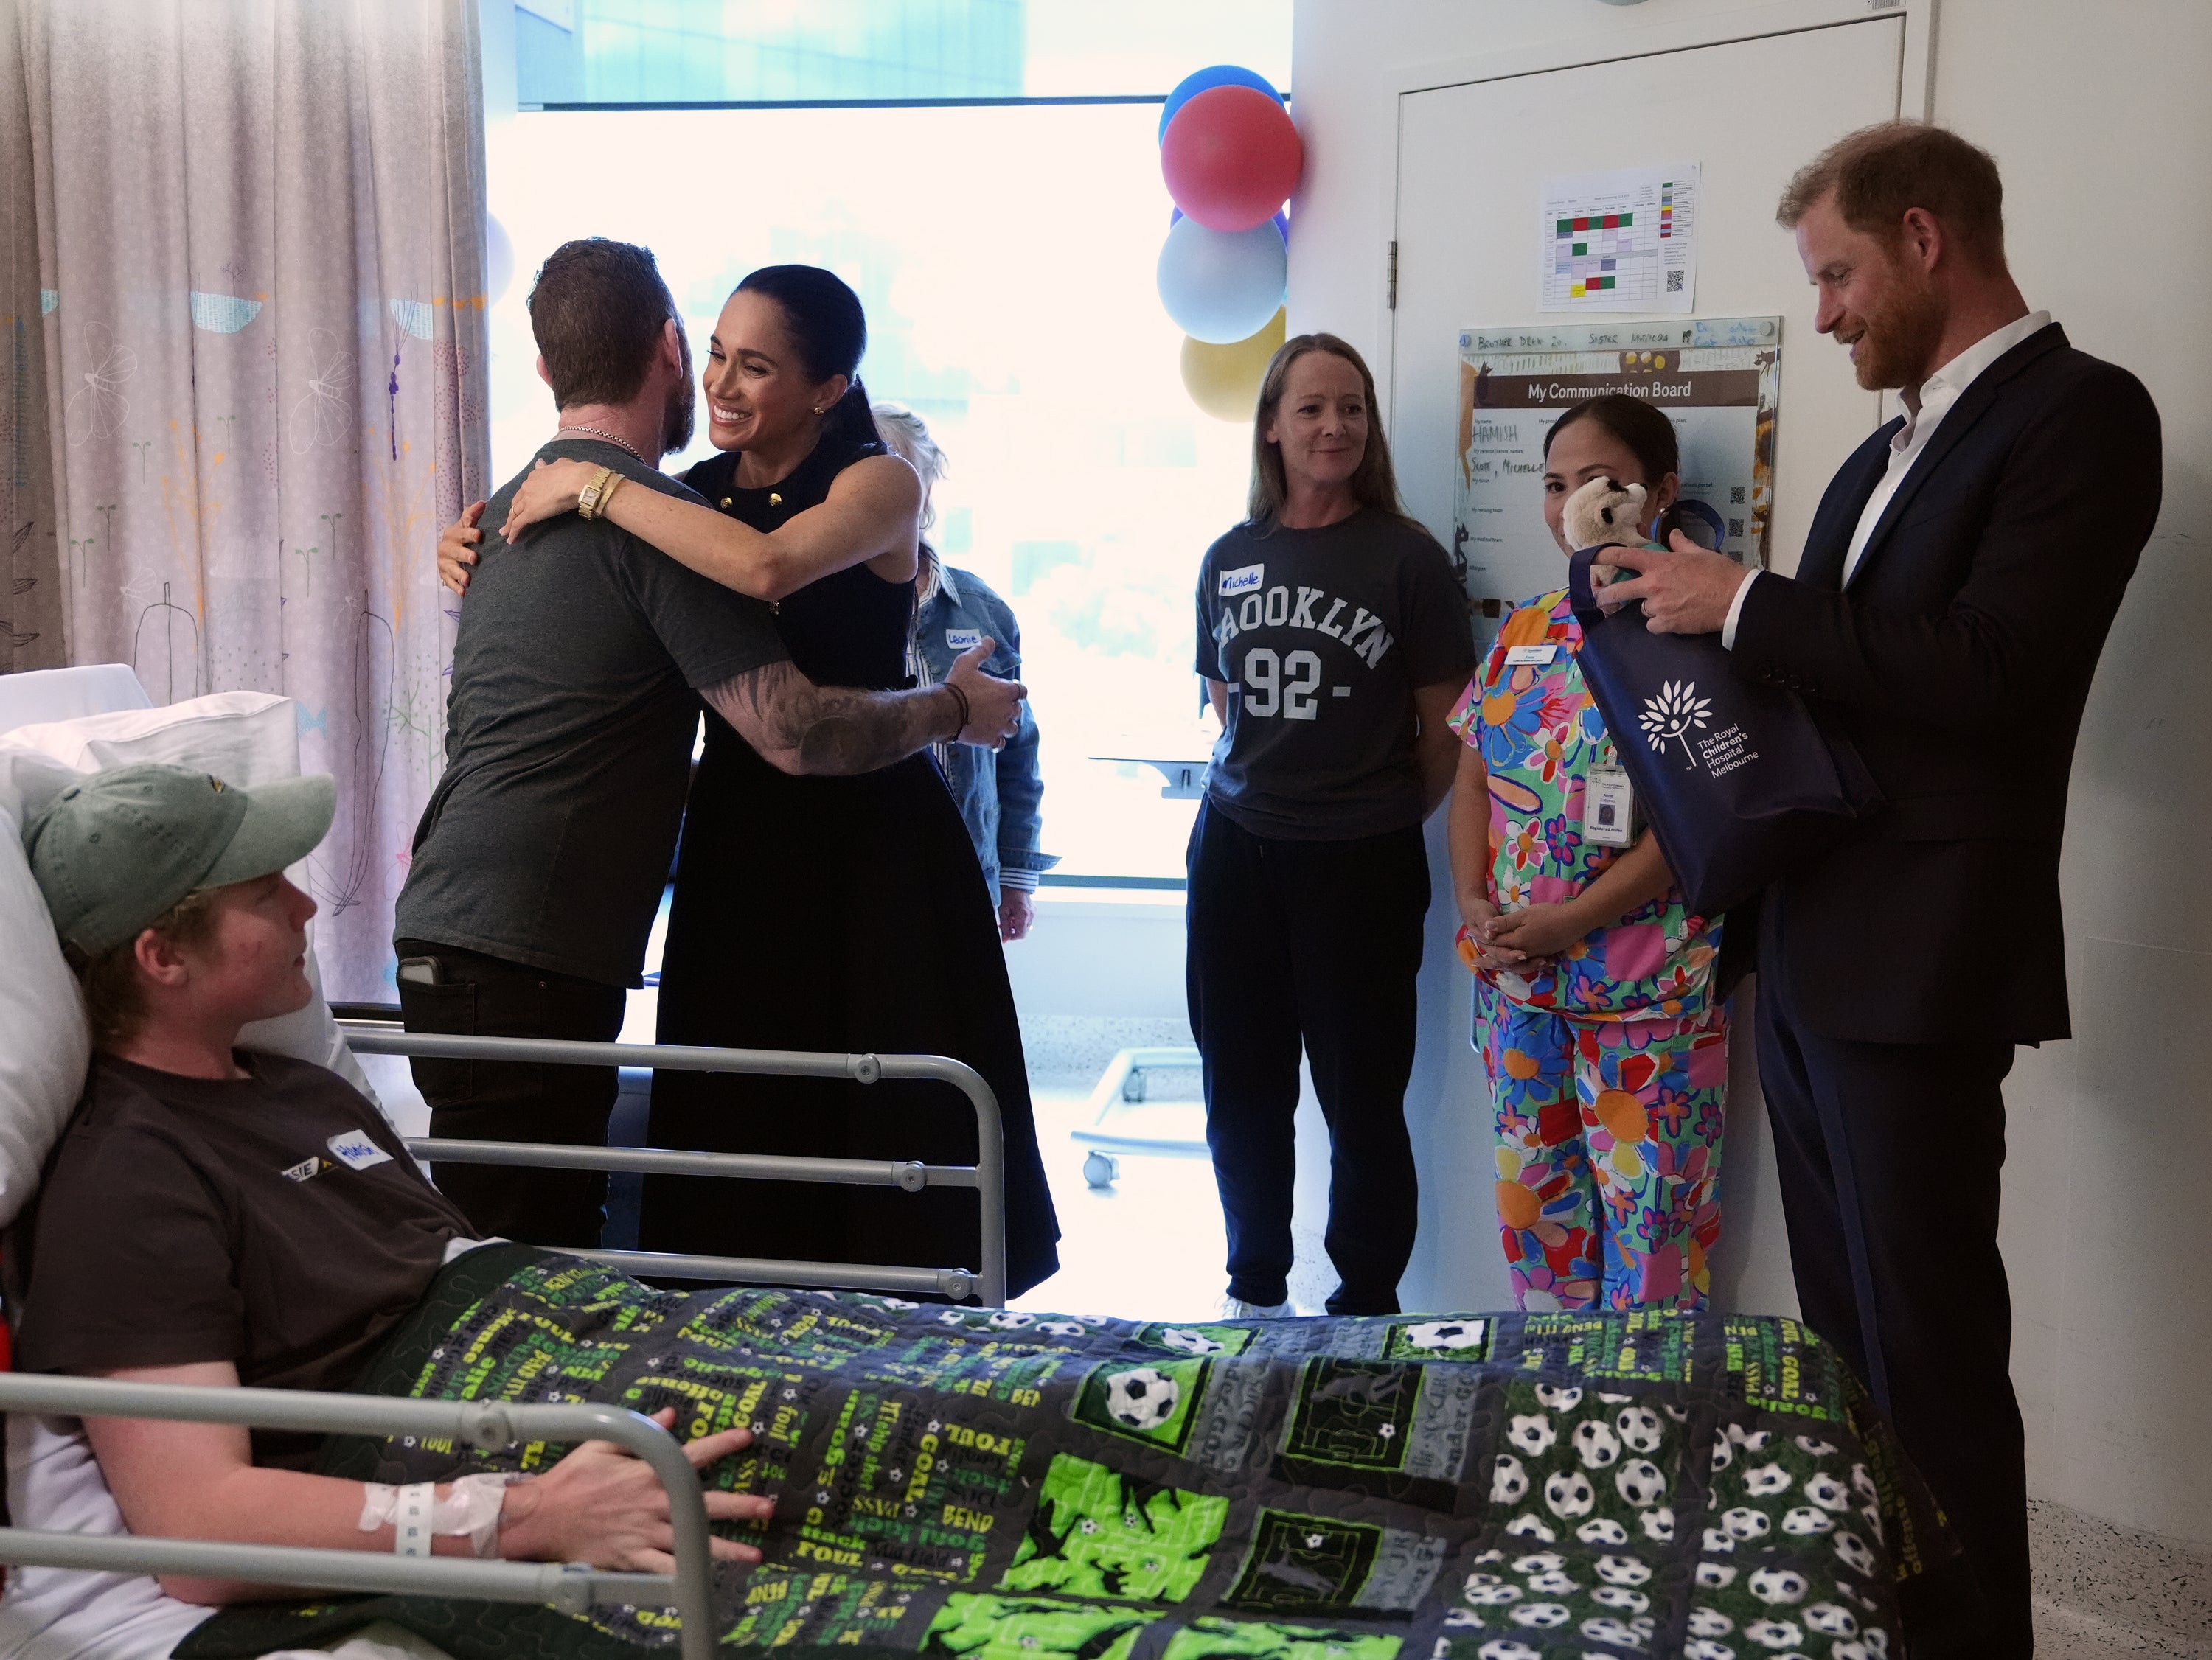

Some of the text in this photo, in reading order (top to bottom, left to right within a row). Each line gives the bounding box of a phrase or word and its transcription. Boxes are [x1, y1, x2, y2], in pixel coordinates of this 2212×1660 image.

[1528, 381, 1691, 402] My Communication Board
[1472, 425, 1517, 443] HAMISH
[1222, 572, 1260, 590] Michelle
[1697, 723, 1740, 750] The Royal
[1703, 732, 1748, 759] Children's
[1706, 744, 1745, 769] Hospital
[1711, 751, 1759, 779] Melbourne
[634, 1376, 724, 1403] offense
[1781, 1355, 1800, 1401] GOAL
[732, 1380, 768, 1429] GOAL
[768, 1404, 799, 1443] foul
[944, 1423, 1012, 1457] FOUL
[904, 1433, 939, 1504] GOAL
[853, 1496, 901, 1519] PASS
[942, 1504, 994, 1534] BEND
[796, 1540, 864, 1568] FOUL
